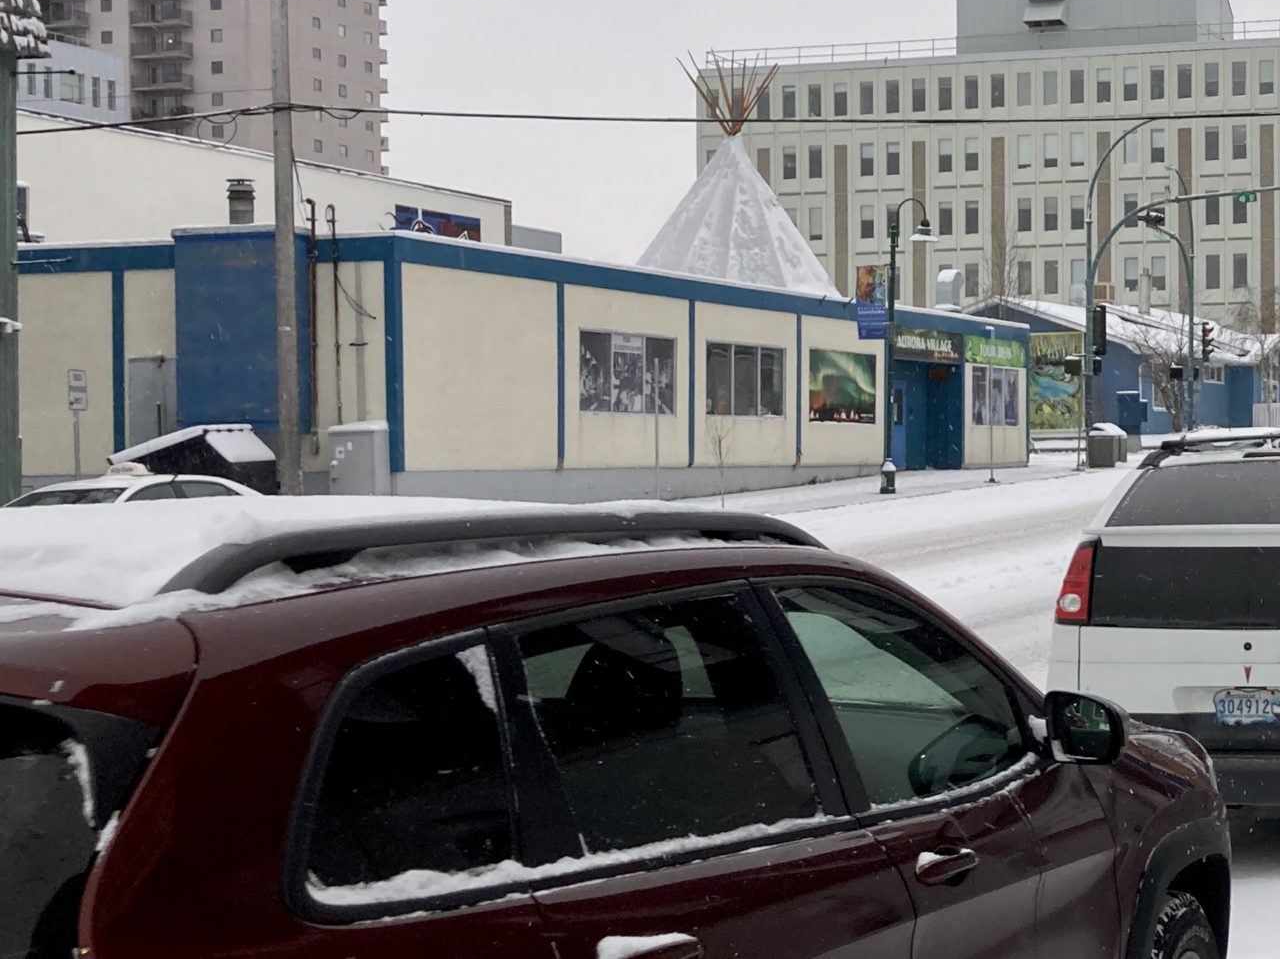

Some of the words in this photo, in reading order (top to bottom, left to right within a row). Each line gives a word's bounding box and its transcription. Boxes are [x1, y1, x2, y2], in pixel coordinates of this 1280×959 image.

[896, 334, 926, 350] AURORA
[926, 337, 952, 353] VILLAGE
[1218, 698, 1270, 714] 304912
